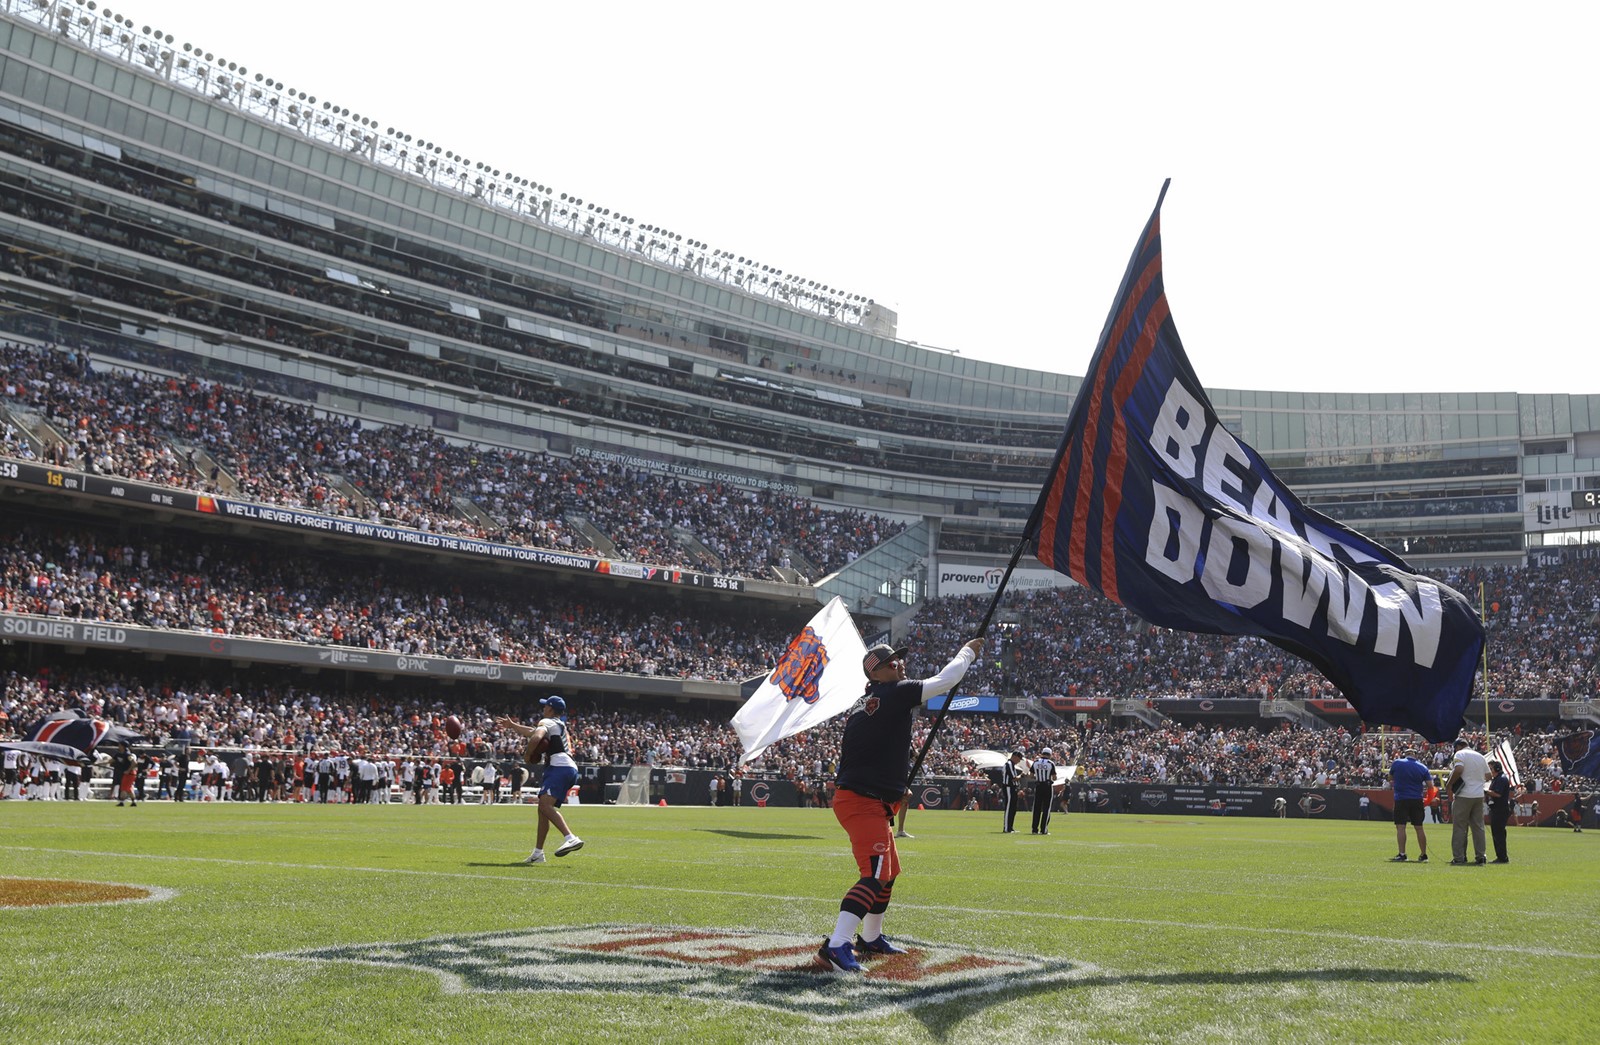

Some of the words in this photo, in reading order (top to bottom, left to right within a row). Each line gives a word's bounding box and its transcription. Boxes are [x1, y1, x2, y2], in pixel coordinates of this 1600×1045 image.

[576, 447, 590, 458] FOR
[591, 449, 669, 471] SECURITY/ASSISTANCE
[670, 464, 687, 474] TEXT
[688, 466, 707, 478] ISSUE
[708, 470, 713, 478] &
[714, 471, 747, 484] LOCATION
[748, 477, 757, 487] TO
[46, 471, 62, 487] 1st
[64, 478, 78, 489] QTR
[111, 486, 125, 497] AND
[151, 494, 161, 503] ON
[162, 494, 173, 505] THE
[1537, 505, 1572, 524] Lite
[226, 503, 257, 518] WE'LL
[259, 509, 292, 524] NEVER
[294, 514, 333, 530] FORGET
[335, 521, 353, 533] THE
[354, 524, 374, 537] WAY
[376, 528, 396, 540] YOU
[397, 531, 440, 547] THRILLED
[441, 539, 458, 550] THE
[459, 540, 490, 554] NATION
[492, 547, 512, 558] WITH
[513, 550, 537, 562] YOUR
[538, 552, 591, 569] T-FORMATION
[610, 564, 620, 574] NFL
[621, 565, 641, 577] Scores
[664, 570, 669, 580] 0
[1146, 478, 1443, 669] DOWN
[694, 574, 698, 584] 6
[713, 578, 728, 589] 9:56
[728, 580, 738, 590] 1st
[942, 572, 985, 584] proven
[990, 574, 1001, 584] IT
[1006, 576, 1033, 588] skyline
[1034, 577, 1053, 586] suite
[3, 618, 74, 639] SOLDIER
[83, 626, 126, 644] FIELD
[330, 650, 348, 664] Lite
[408, 660, 429, 671] PNC
[454, 664, 487, 674] proven
[522, 671, 555, 683] verizon
